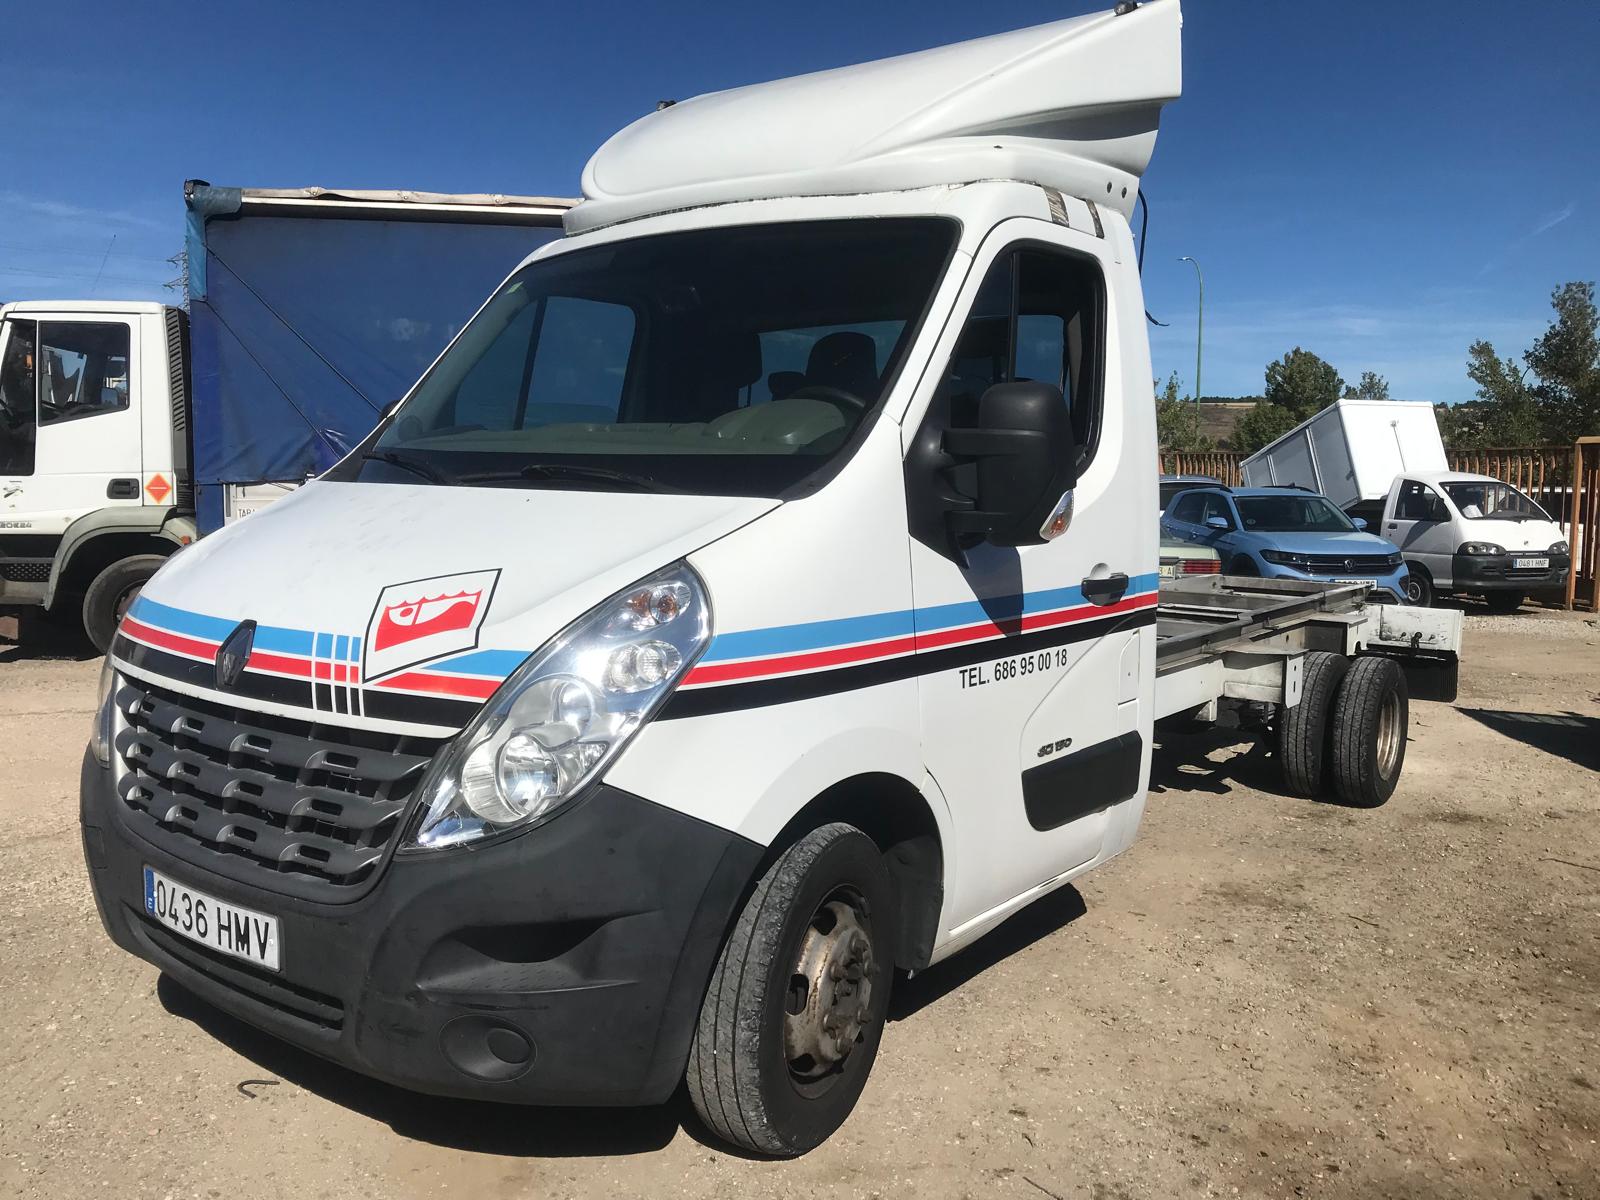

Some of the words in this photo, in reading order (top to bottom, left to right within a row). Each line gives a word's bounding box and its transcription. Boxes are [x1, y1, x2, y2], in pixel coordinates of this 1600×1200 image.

[959, 666, 990, 689] TEL.
[994, 659, 1017, 681] 686
[1020, 655, 1034, 676] 95
[1038, 652, 1051, 672] 00
[1055, 648, 1067, 667] 18
[157, 880, 208, 938] 0436
[217, 907, 269, 960] HMV
